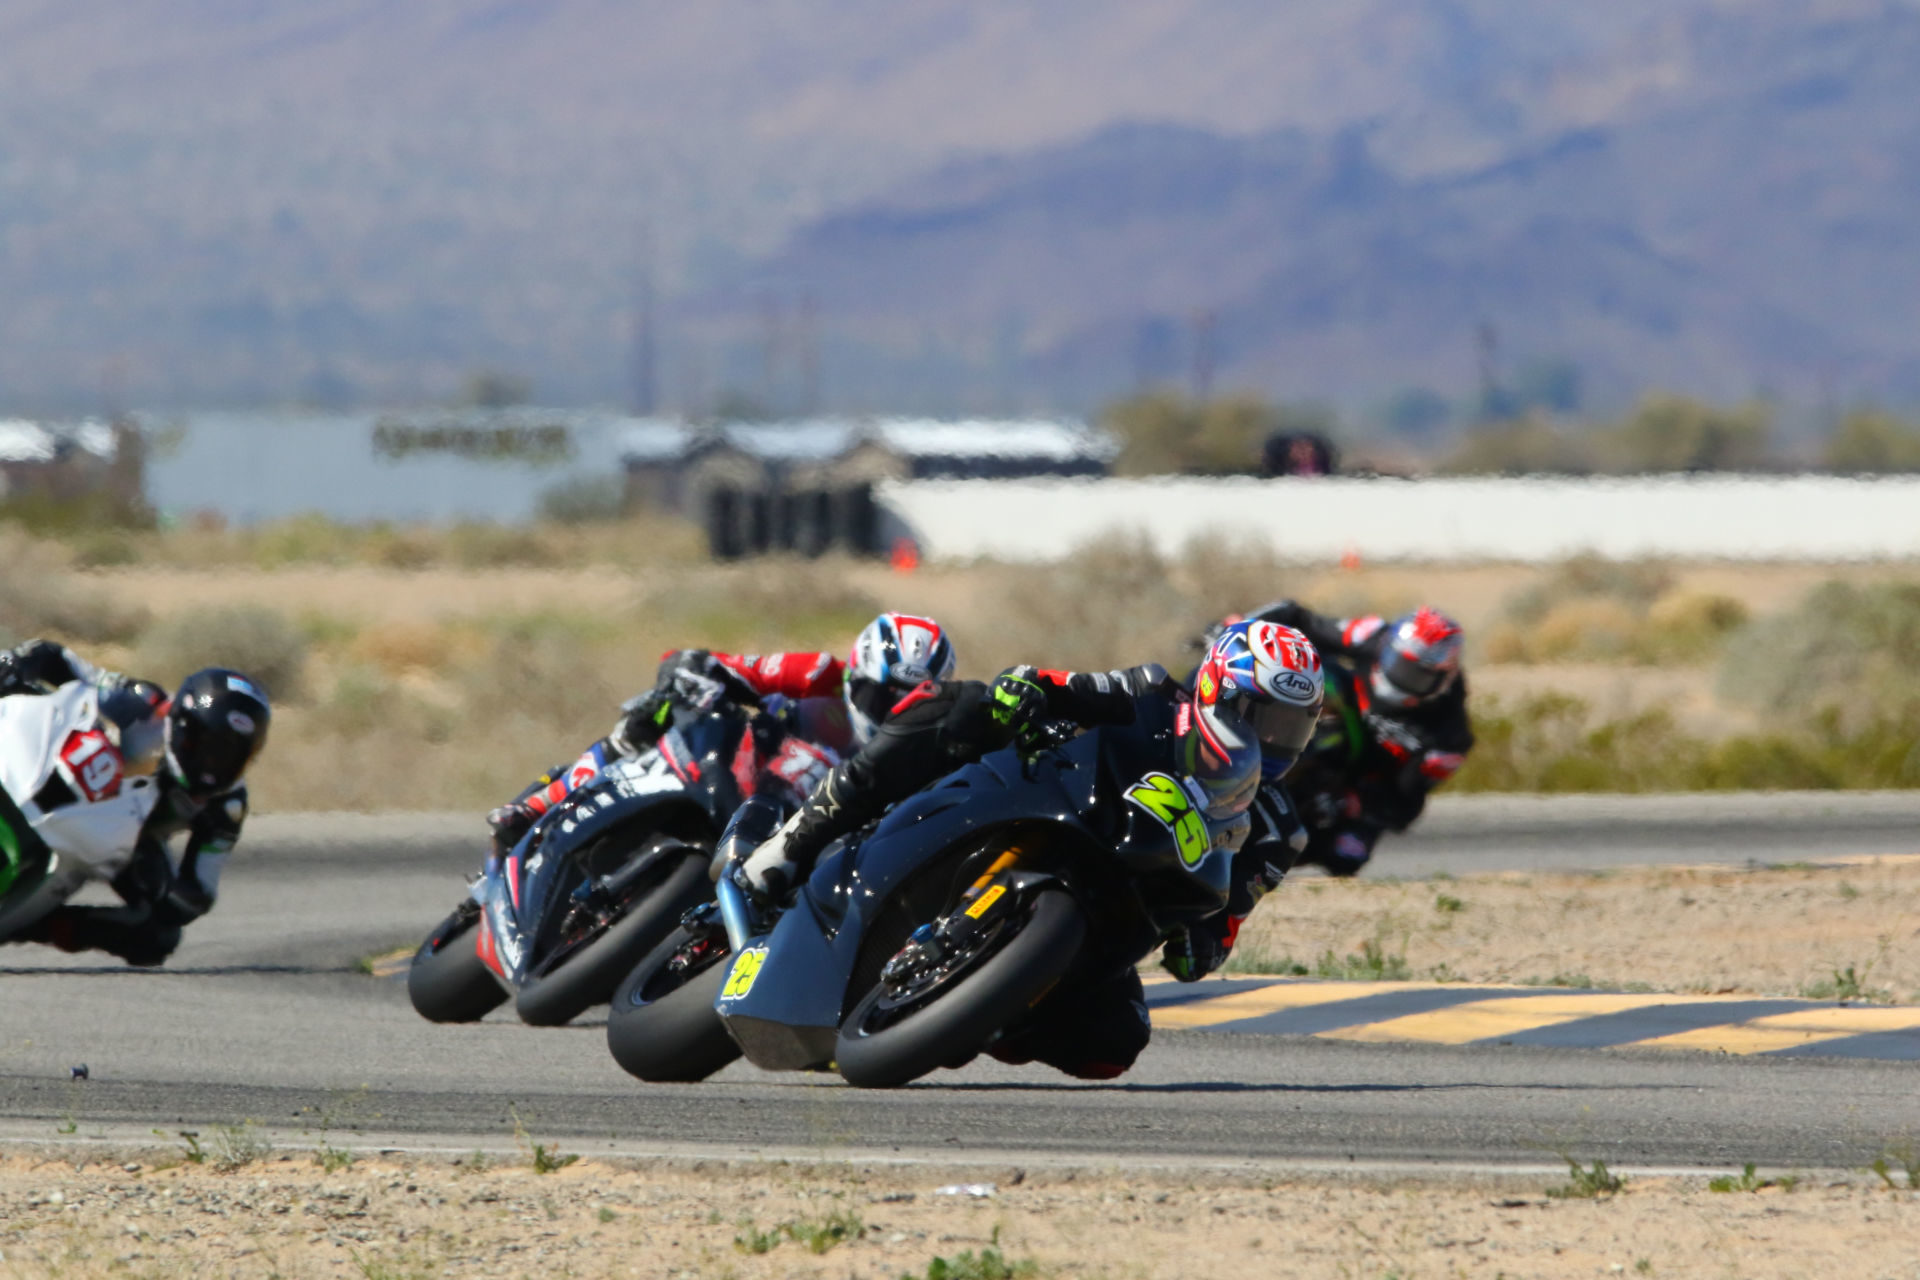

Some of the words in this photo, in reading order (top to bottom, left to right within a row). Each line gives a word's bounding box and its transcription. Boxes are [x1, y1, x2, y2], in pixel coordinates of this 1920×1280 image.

[1277, 673, 1312, 691] Arai
[67, 736, 118, 792] 19
[1126, 773, 1210, 868] 25
[722, 949, 769, 998] 25
